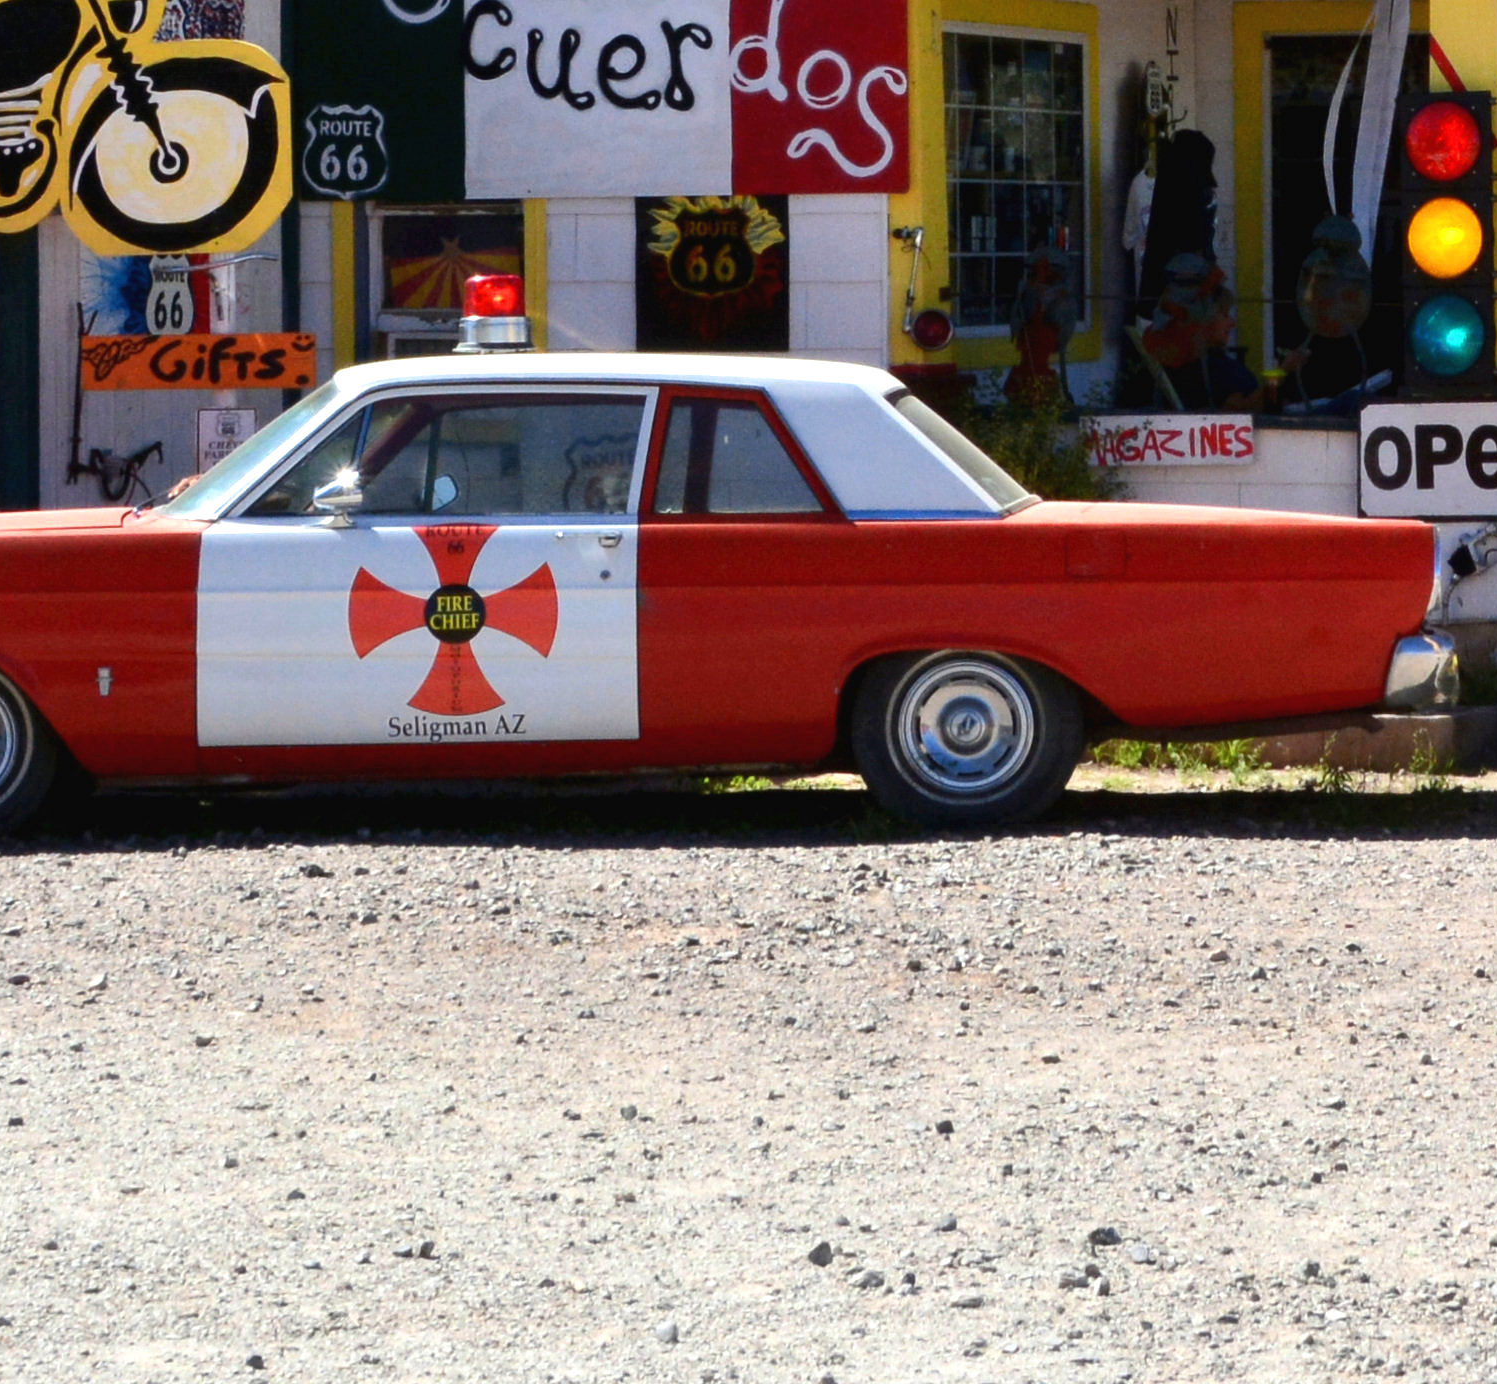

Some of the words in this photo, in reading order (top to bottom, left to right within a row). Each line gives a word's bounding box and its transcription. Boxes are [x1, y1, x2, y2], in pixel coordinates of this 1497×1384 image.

[318, 118, 373, 139] ROUTE
[319, 145, 375, 184] 66
[684, 220, 738, 238] ROUTE
[686, 242, 736, 283] 66
[154, 291, 183, 330] 66
[425, 524, 484, 538] ROUTE
[447, 540, 465, 554] 66
[436, 595, 473, 612] FIRE
[429, 612, 480, 631] CHIEF
[388, 716, 487, 742] Seligman
[494, 714, 527, 736] AZ
